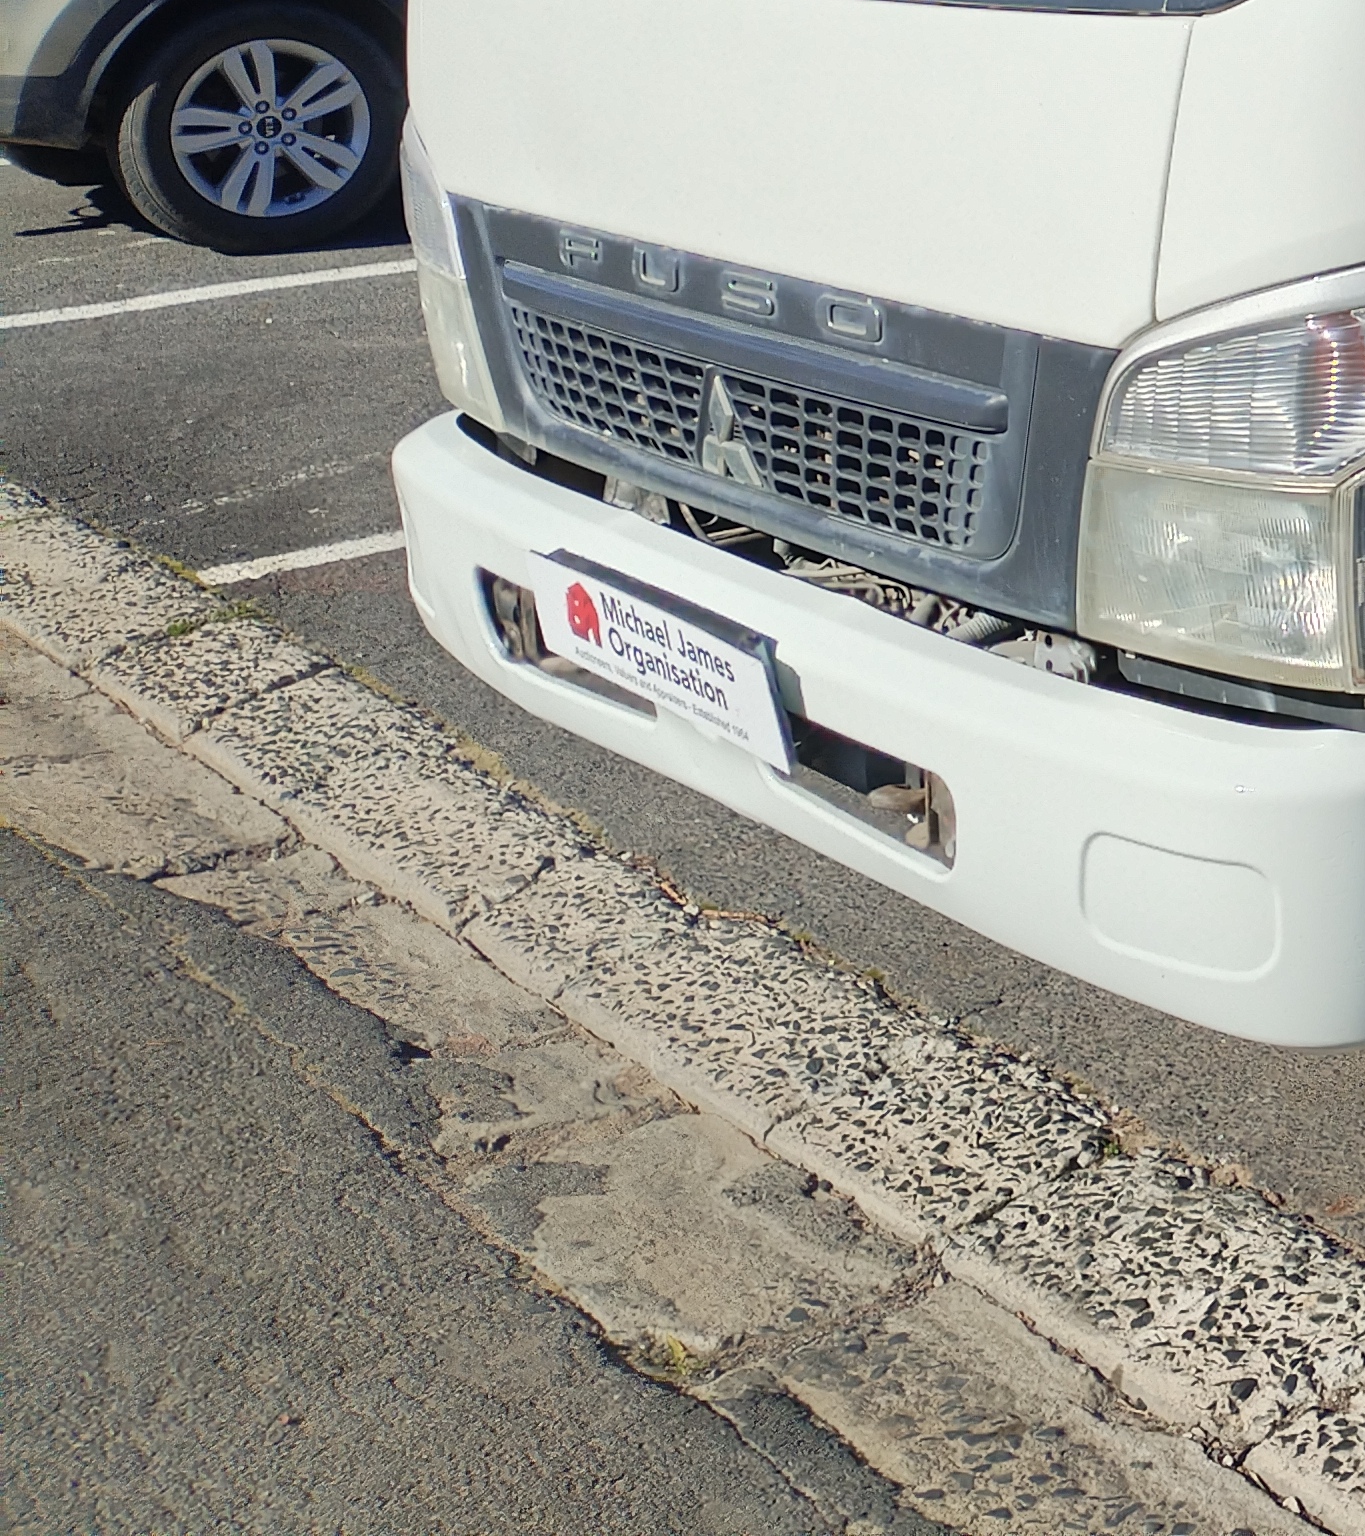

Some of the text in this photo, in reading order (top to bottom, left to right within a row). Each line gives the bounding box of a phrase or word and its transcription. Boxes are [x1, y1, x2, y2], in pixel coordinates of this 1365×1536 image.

[559, 228, 884, 346] FUSO
[600, 591, 735, 682] Michael James
[608, 627, 728, 710] Organisation
